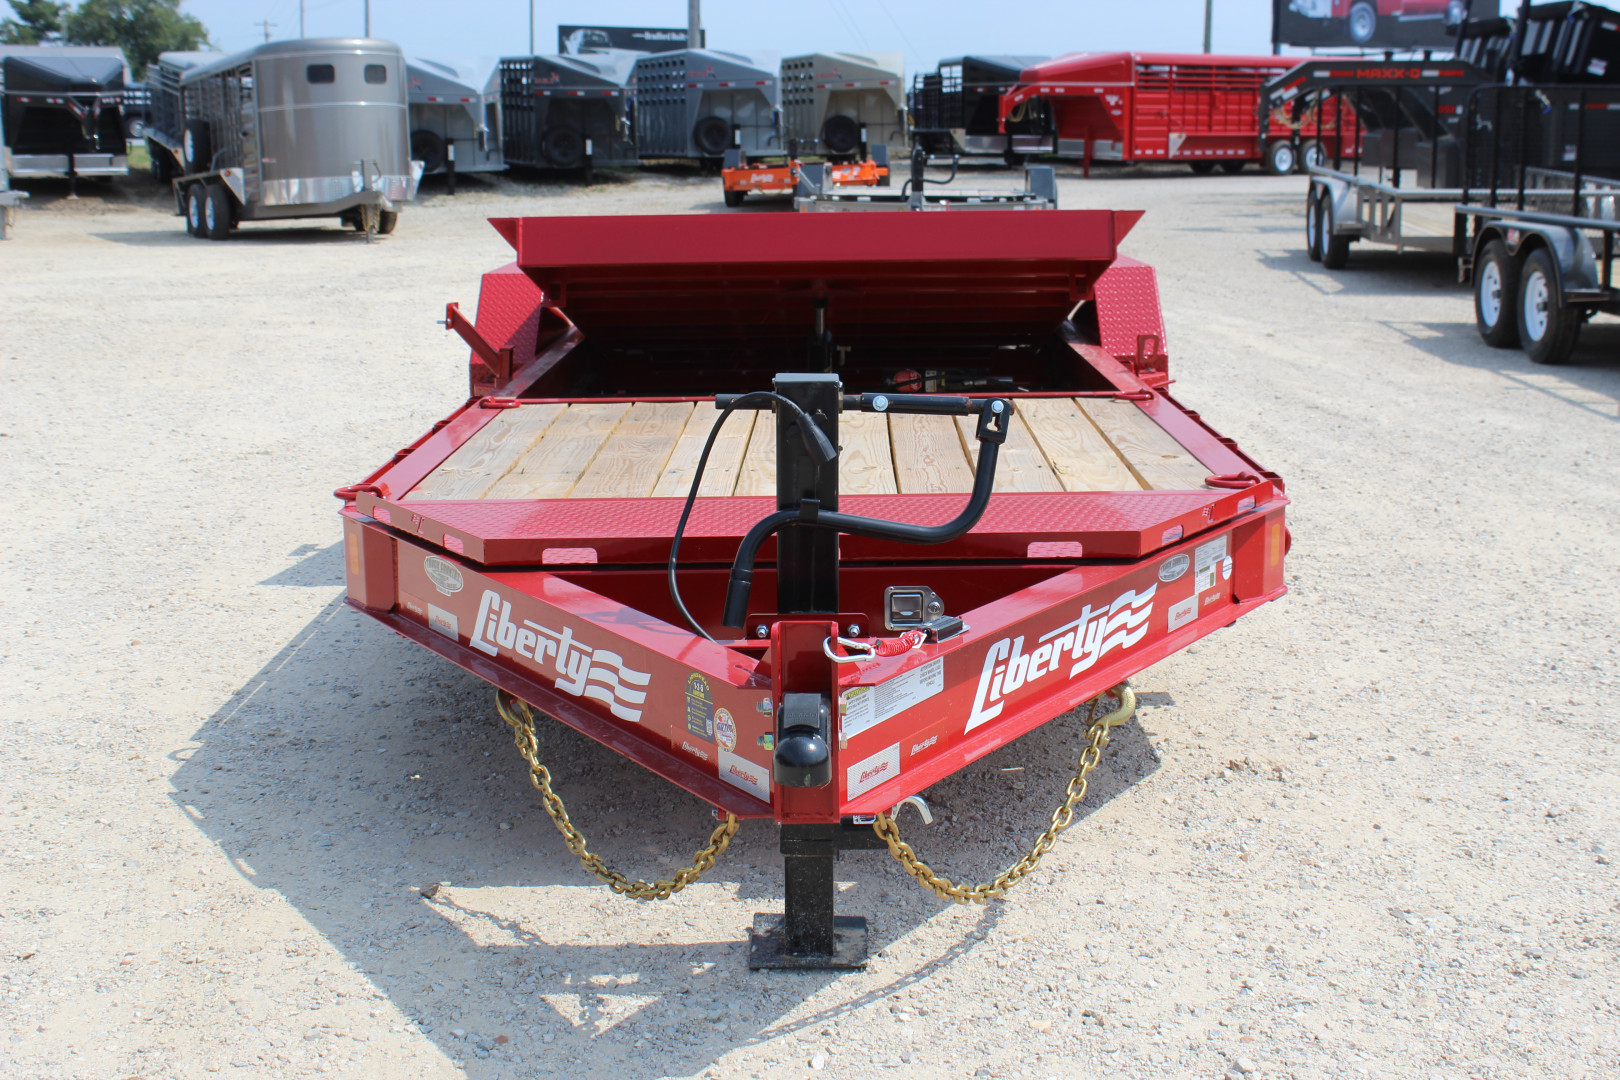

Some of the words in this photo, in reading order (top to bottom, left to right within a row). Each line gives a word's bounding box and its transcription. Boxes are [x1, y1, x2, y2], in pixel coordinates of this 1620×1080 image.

[1356, 68, 1421, 79] MAXX-D
[469, 589, 594, 697] Liberty
[963, 603, 1111, 736] Liberty
